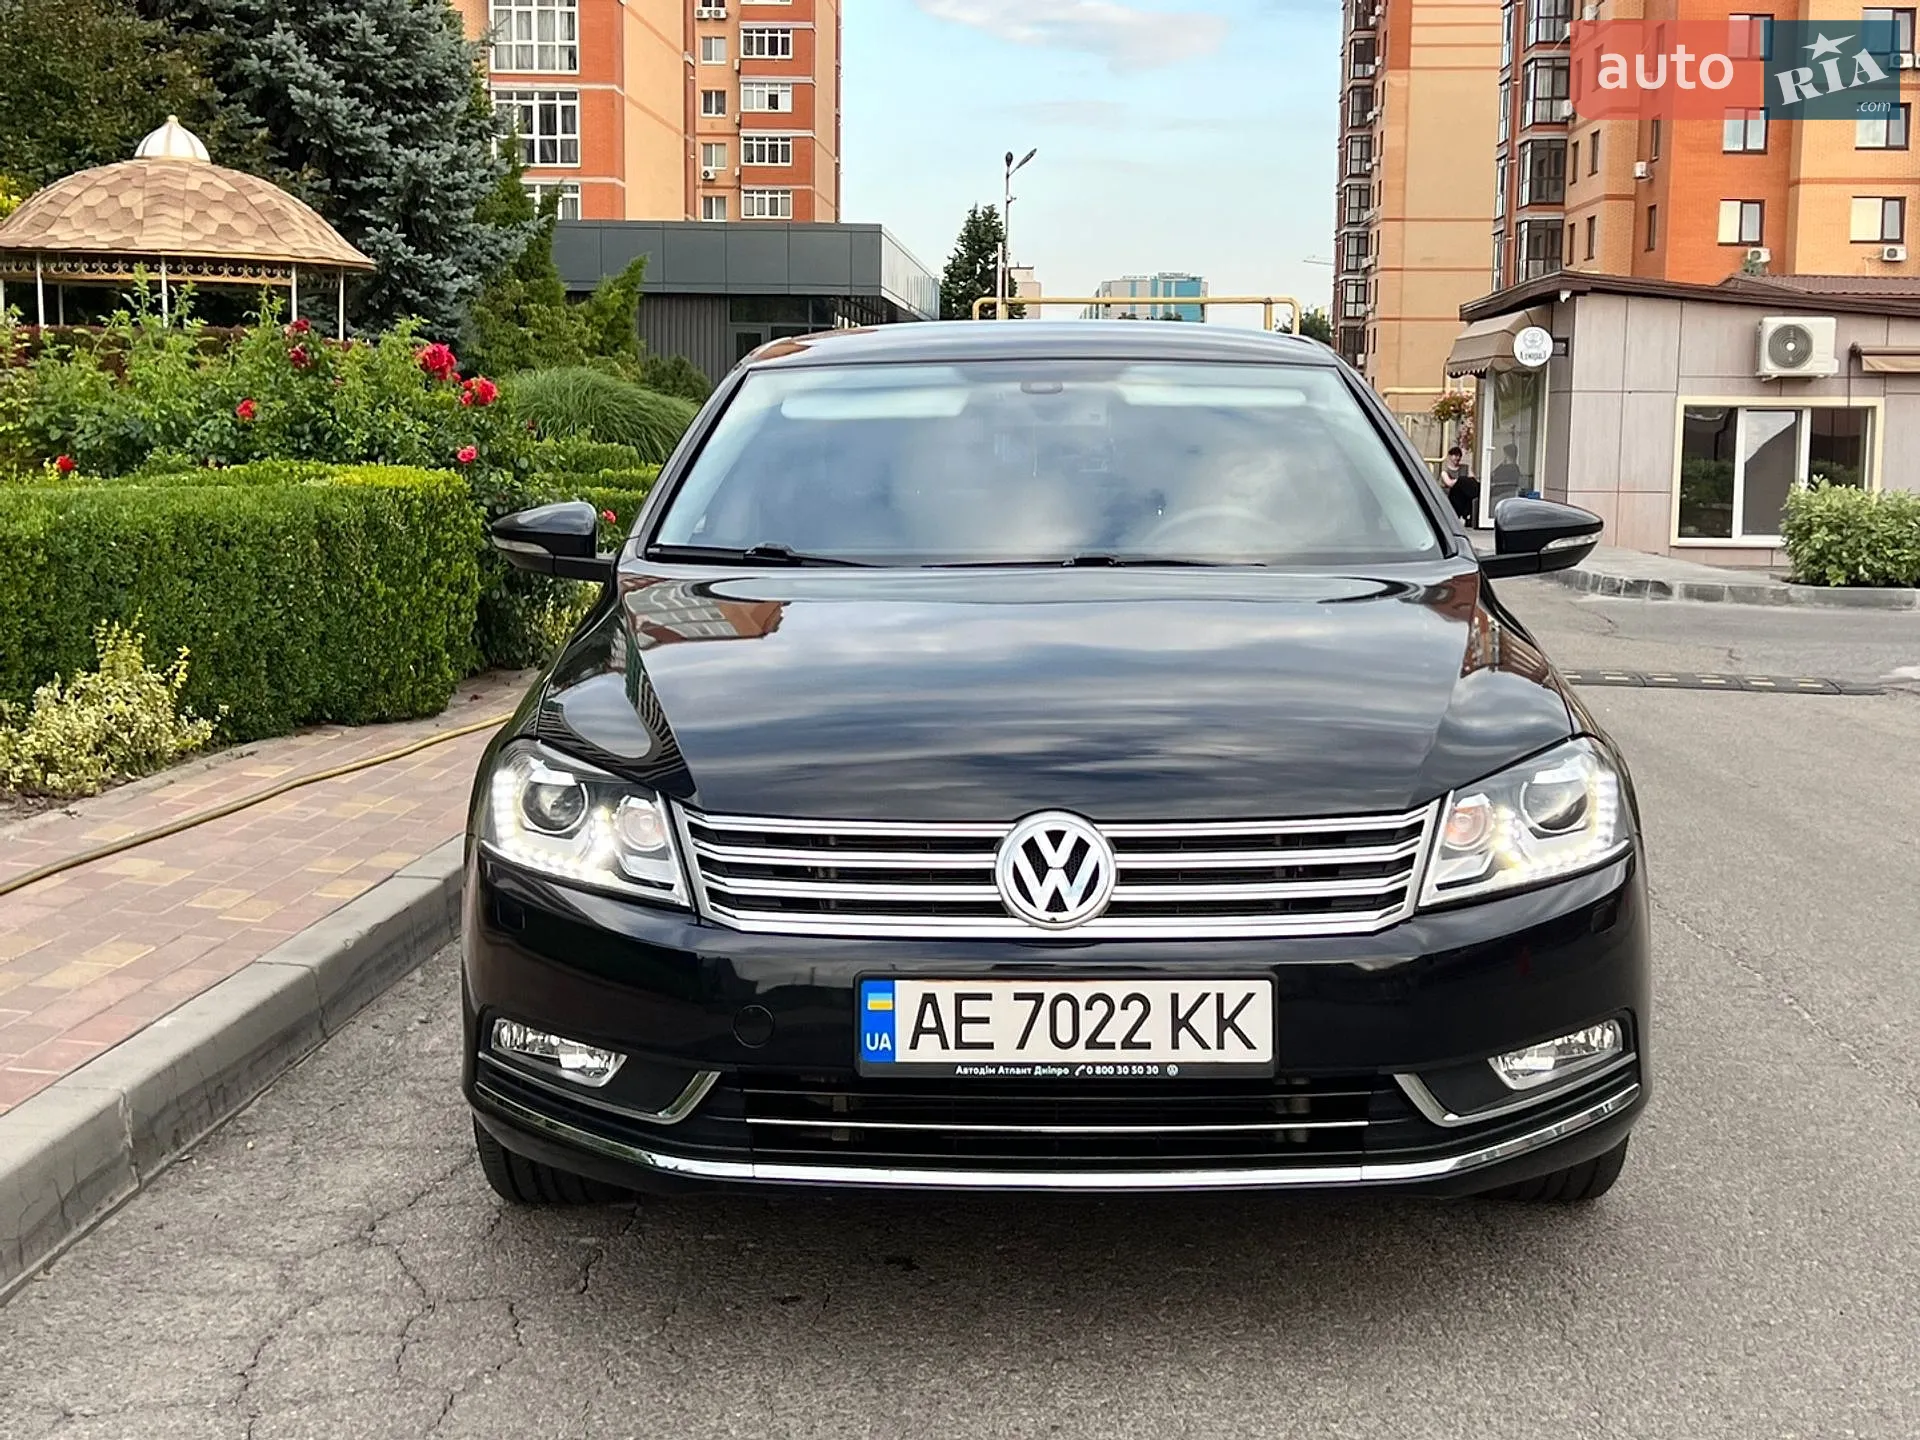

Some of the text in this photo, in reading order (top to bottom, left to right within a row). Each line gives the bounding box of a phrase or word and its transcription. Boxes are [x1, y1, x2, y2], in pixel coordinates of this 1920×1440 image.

[908, 993, 1257, 1050] AE 7022 KK
[866, 1032, 892, 1051] UA
[1034, 1065, 1070, 1077] Дніпро
[1086, 1065, 1094, 1075] 0
[1095, 1065, 1115, 1075] 800
[1117, 1065, 1129, 1075] 30
[1131, 1065, 1144, 1075] 50
[1146, 1065, 1159, 1075] 30
